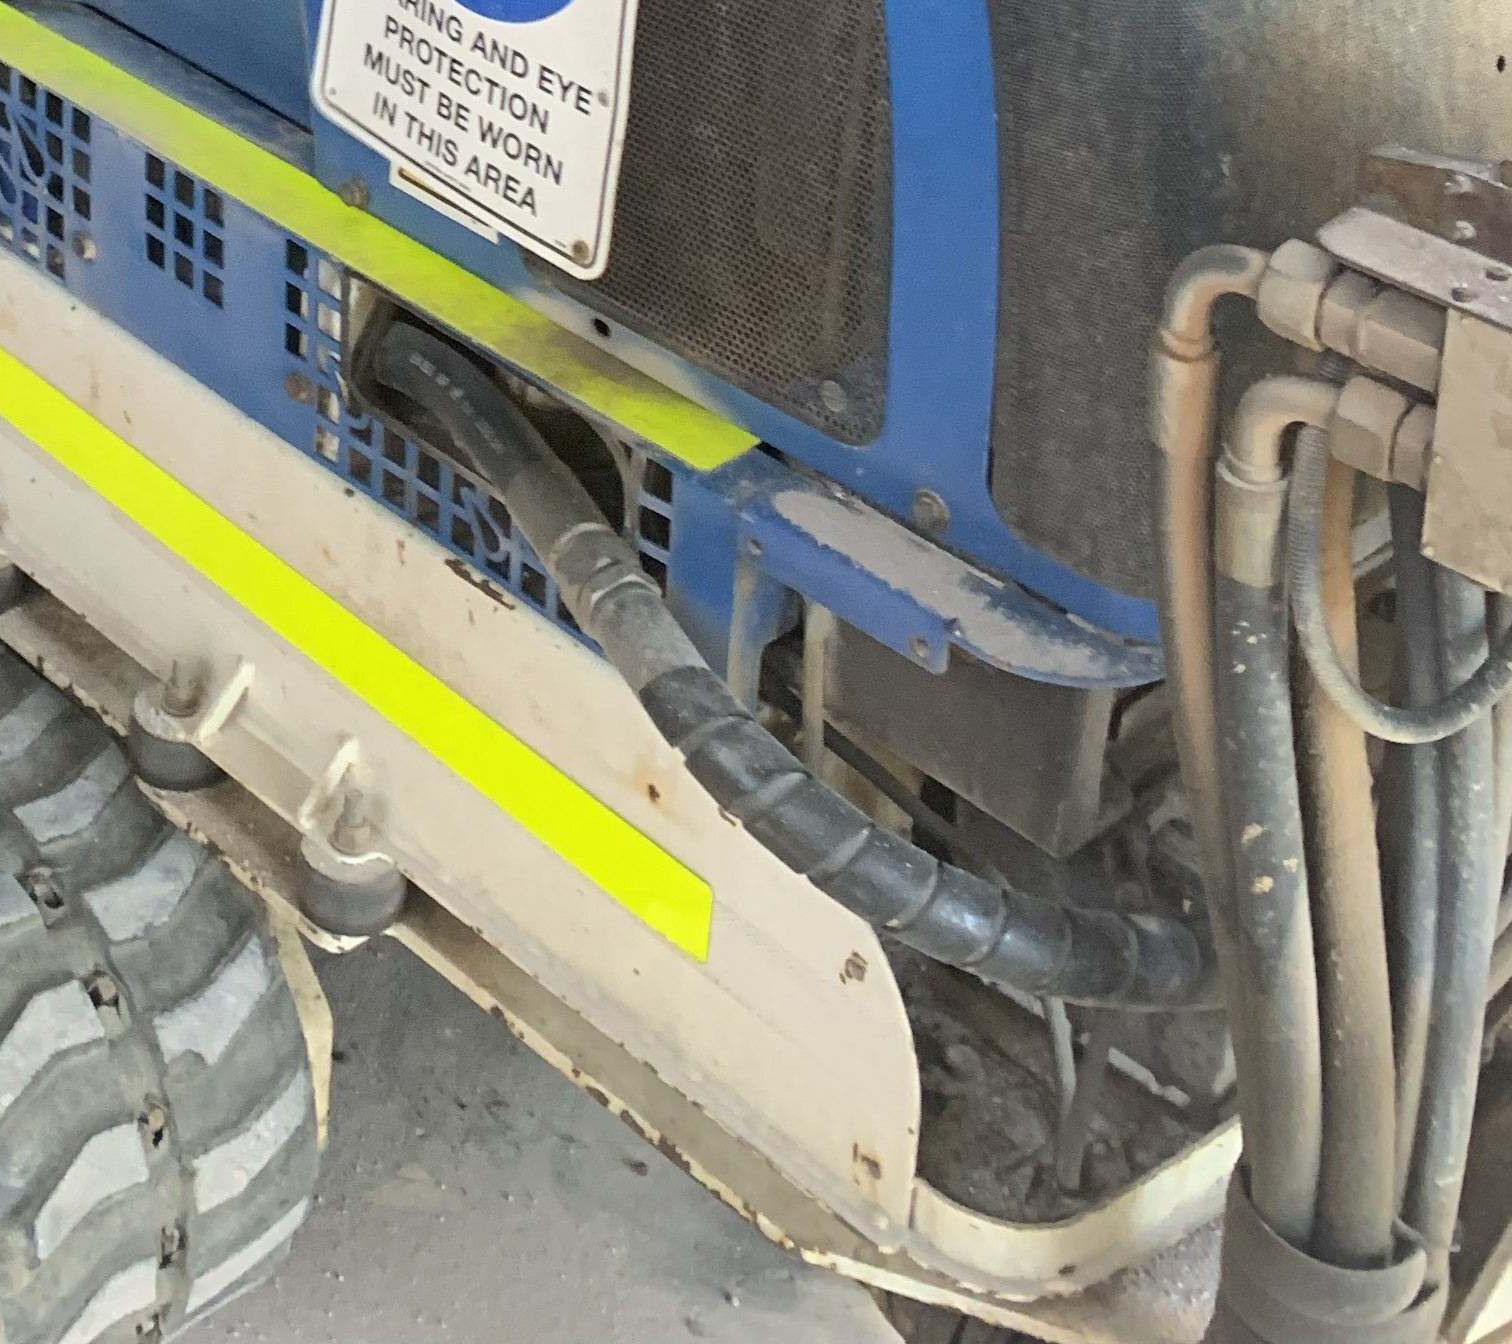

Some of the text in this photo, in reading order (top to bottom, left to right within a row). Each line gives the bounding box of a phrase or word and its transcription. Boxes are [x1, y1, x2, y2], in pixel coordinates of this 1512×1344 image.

[362, 42, 431, 105] MUST
[437, 90, 472, 133] BE
[477, 114, 565, 186] WORN
[384, 14, 550, 135] PROTECTION
[470, 30, 530, 79] AND
[537, 63, 594, 116] EYE
[372, 91, 398, 129] IN
[404, 111, 460, 167] THIS
[464, 154, 539, 217] AREA
